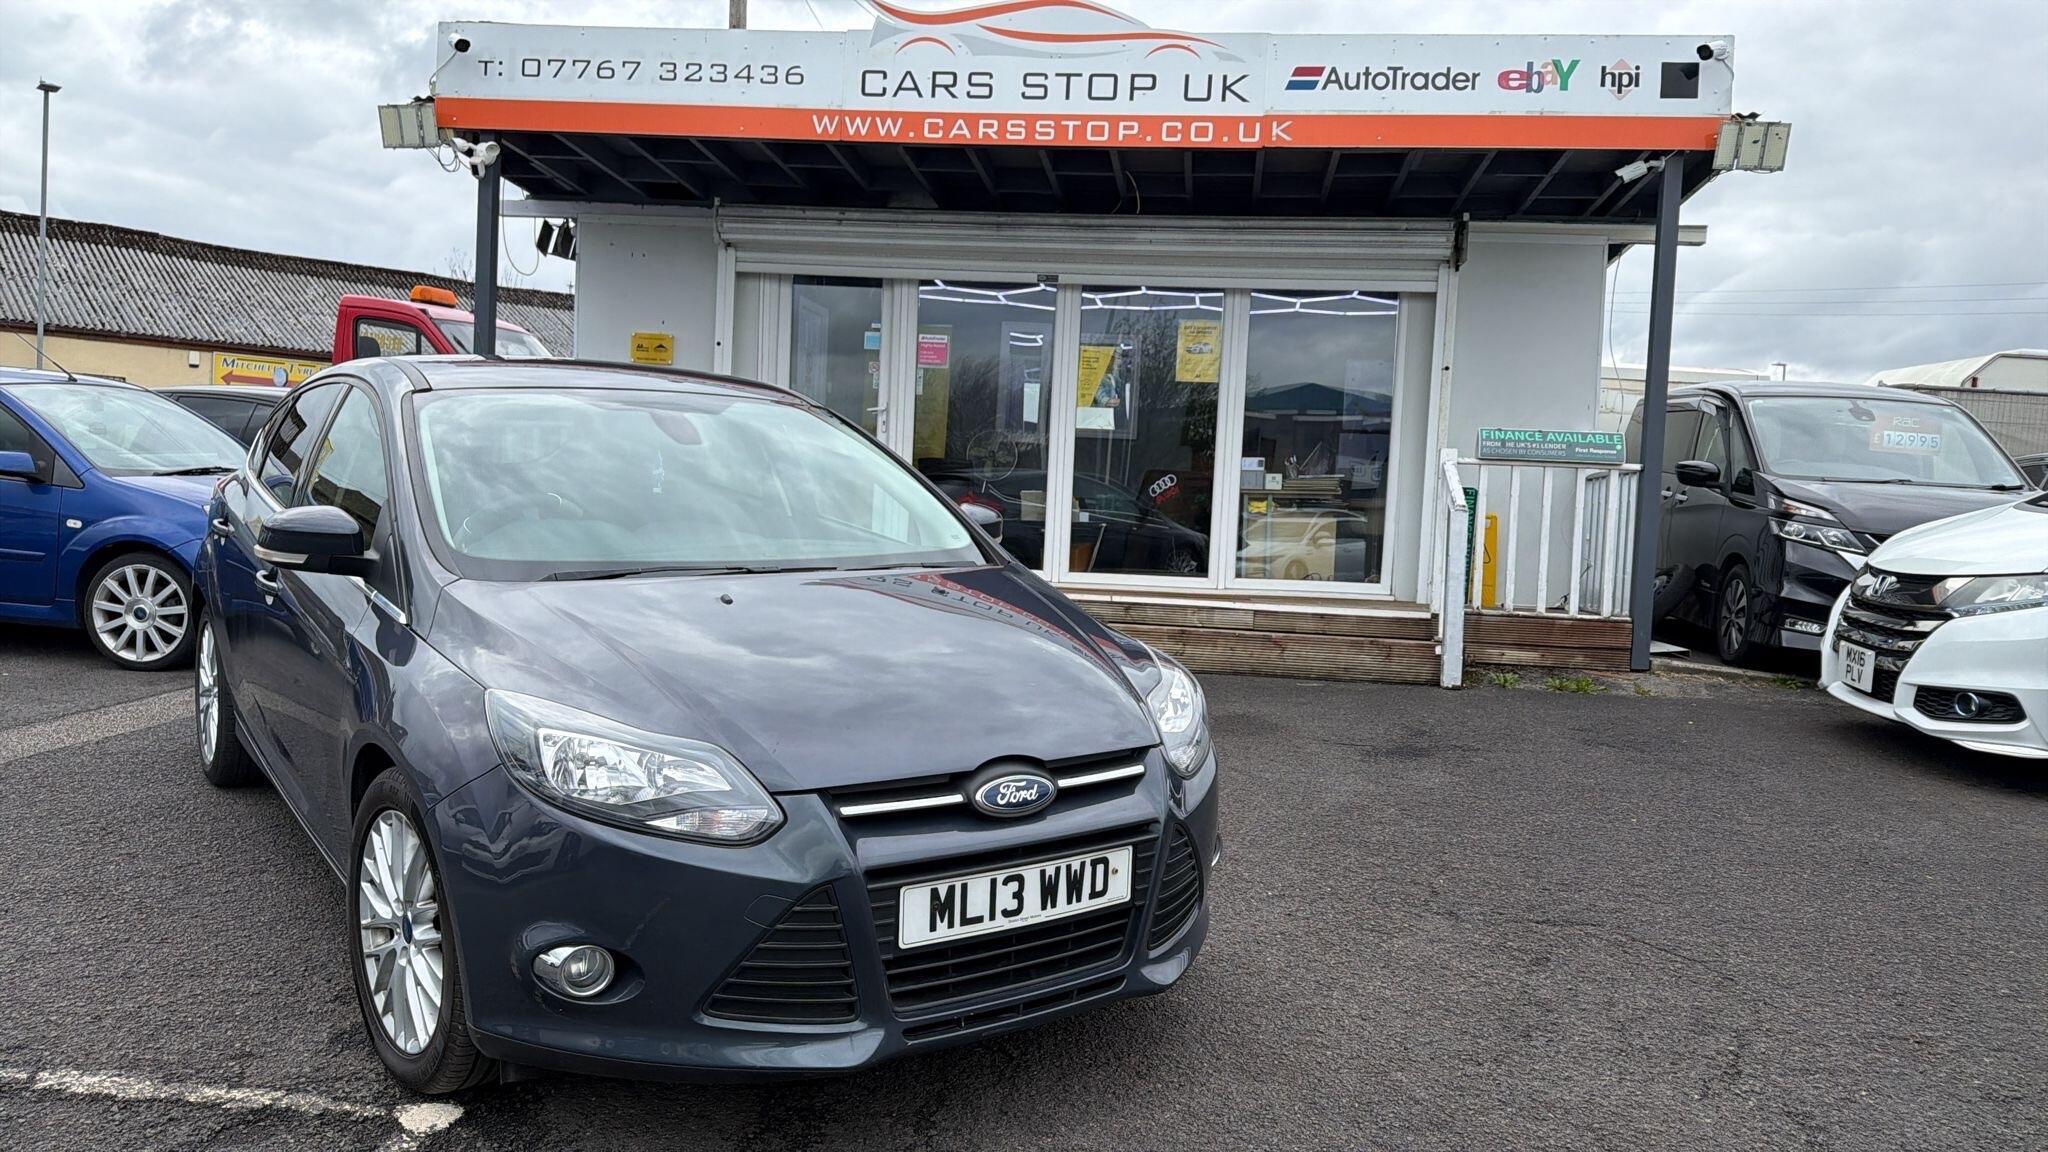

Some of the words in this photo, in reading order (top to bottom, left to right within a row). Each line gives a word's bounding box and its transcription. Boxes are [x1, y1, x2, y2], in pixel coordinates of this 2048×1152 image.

[478, 60, 504, 77] T:
[521, 58, 642, 81] 07767
[659, 62, 805, 85] 323436
[1321, 66, 1480, 92] AutoTrader
[1600, 65, 1641, 95] hpi
[860, 69, 993, 99] CARS
[1021, 72, 1158, 102] STOP
[1183, 73, 1250, 103] UK
[812, 114, 1294, 144] WWW.CARSSTOP.CO.UK
[1482, 430, 1544, 441] FINANCE
[1546, 432, 1623, 445] AVAILABLE
[1885, 433, 1940, 449] 12995
[1846, 645, 1866, 668] MX16
[1845, 663, 1864, 684] PLV
[997, 781, 1039, 805] Ford
[929, 873, 1026, 933] ML13
[1039, 856, 1110, 911] WWD
